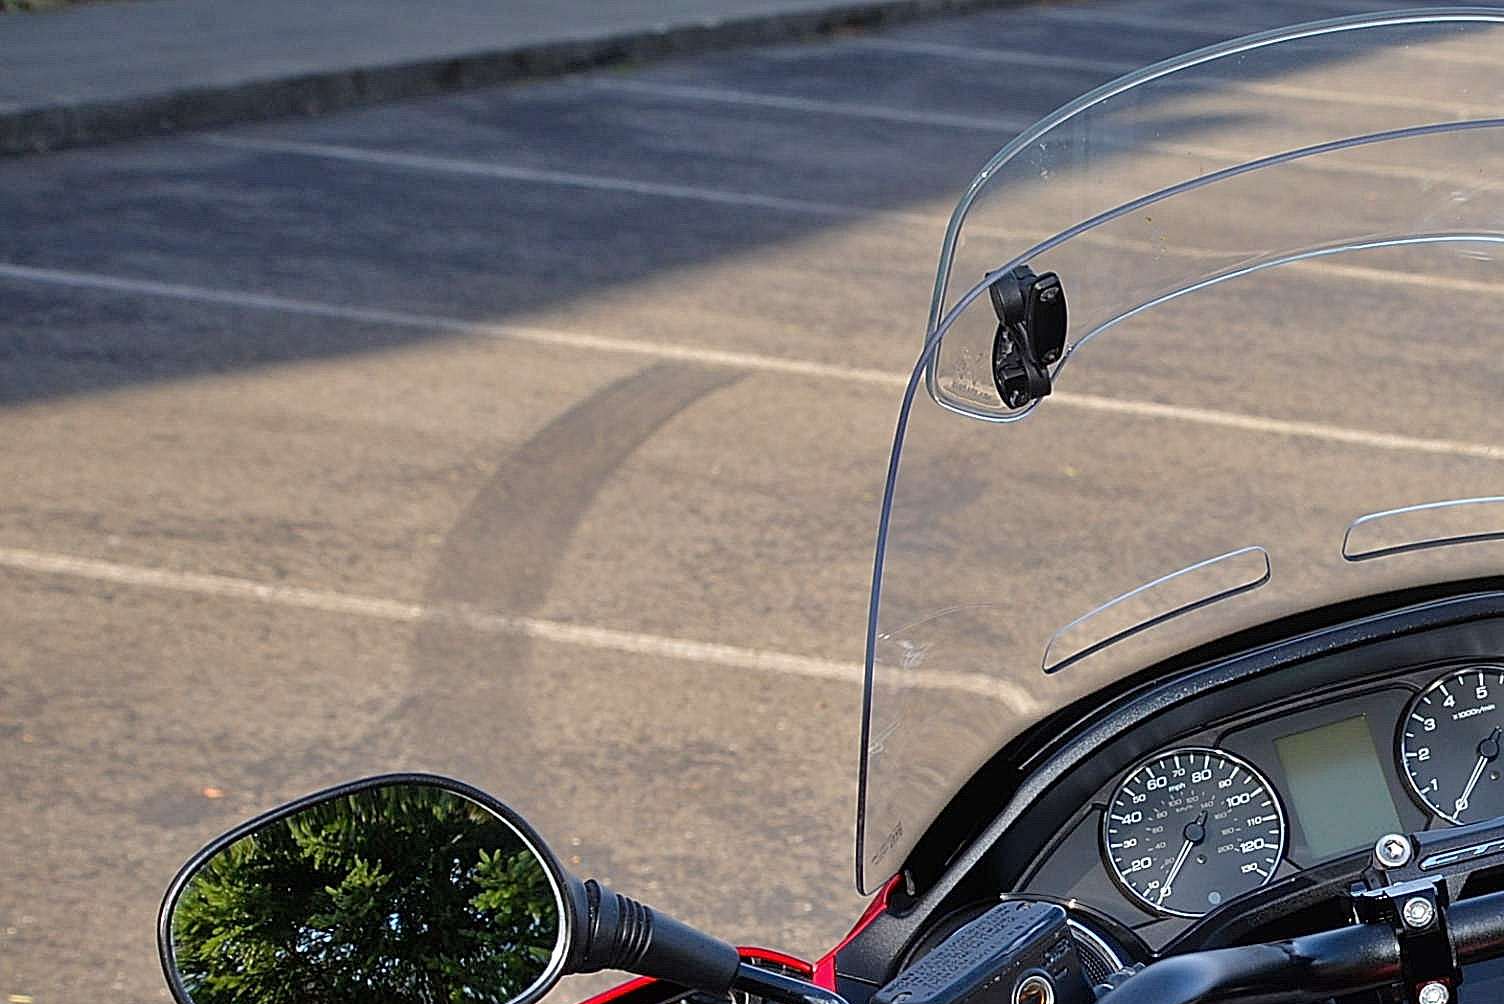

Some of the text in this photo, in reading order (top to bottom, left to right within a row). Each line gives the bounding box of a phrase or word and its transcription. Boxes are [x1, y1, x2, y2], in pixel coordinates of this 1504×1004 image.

[1475, 686, 1488, 699] 5
[1443, 695, 1456, 707] 4
[1423, 718, 1436, 731] 3
[1418, 748, 1430, 760] 2
[1172, 768, 1185, 778] 70
[1191, 769, 1212, 783] 80
[1146, 777, 1167, 790] 60
[1168, 783, 1186, 793] mph
[1218, 778, 1232, 789] 90
[1430, 778, 1438, 791] 1
[1132, 794, 1146, 804] 50
[1226, 793, 1250, 808] 100
[1121, 811, 1142, 824] 40
[1247, 816, 1262, 827] 110
[1123, 839, 1137, 849] 30
[1240, 838, 1264, 854] 120
[1131, 857, 1151, 872] 20
[1241, 863, 1257, 873] 130
[1148, 881, 1160, 889] 10
